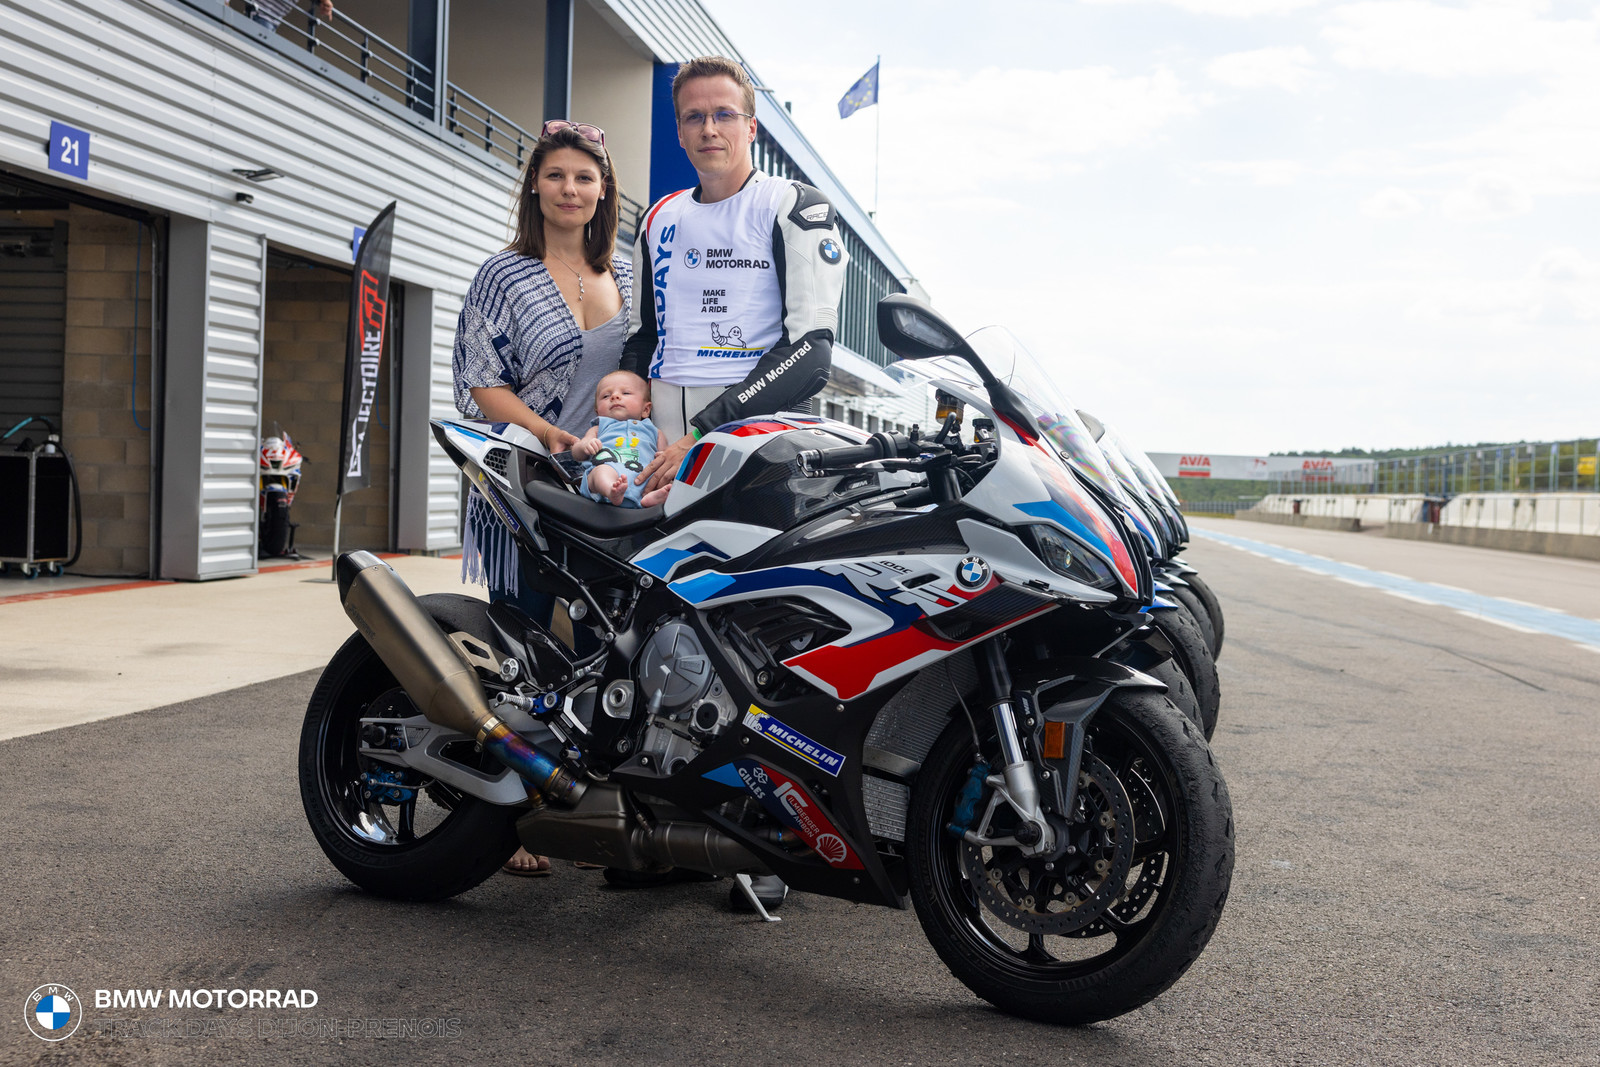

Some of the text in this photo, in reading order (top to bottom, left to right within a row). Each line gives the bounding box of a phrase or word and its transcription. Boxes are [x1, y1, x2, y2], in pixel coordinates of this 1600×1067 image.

[61, 136, 79, 166] 21
[706, 248, 733, 258] BMW
[705, 259, 770, 270] MOTORRAD
[702, 289, 726, 297] MAKE
[702, 297, 719, 305] LIFE
[701, 305, 728, 313] A RIDE
[696, 349, 764, 359] MICHELIN
[737, 341, 812, 404] BMW Motorrad
[1178, 455, 1211, 467] AVIA
[768, 723, 839, 767] MICHELIN
[738, 767, 766, 799] GILLES
